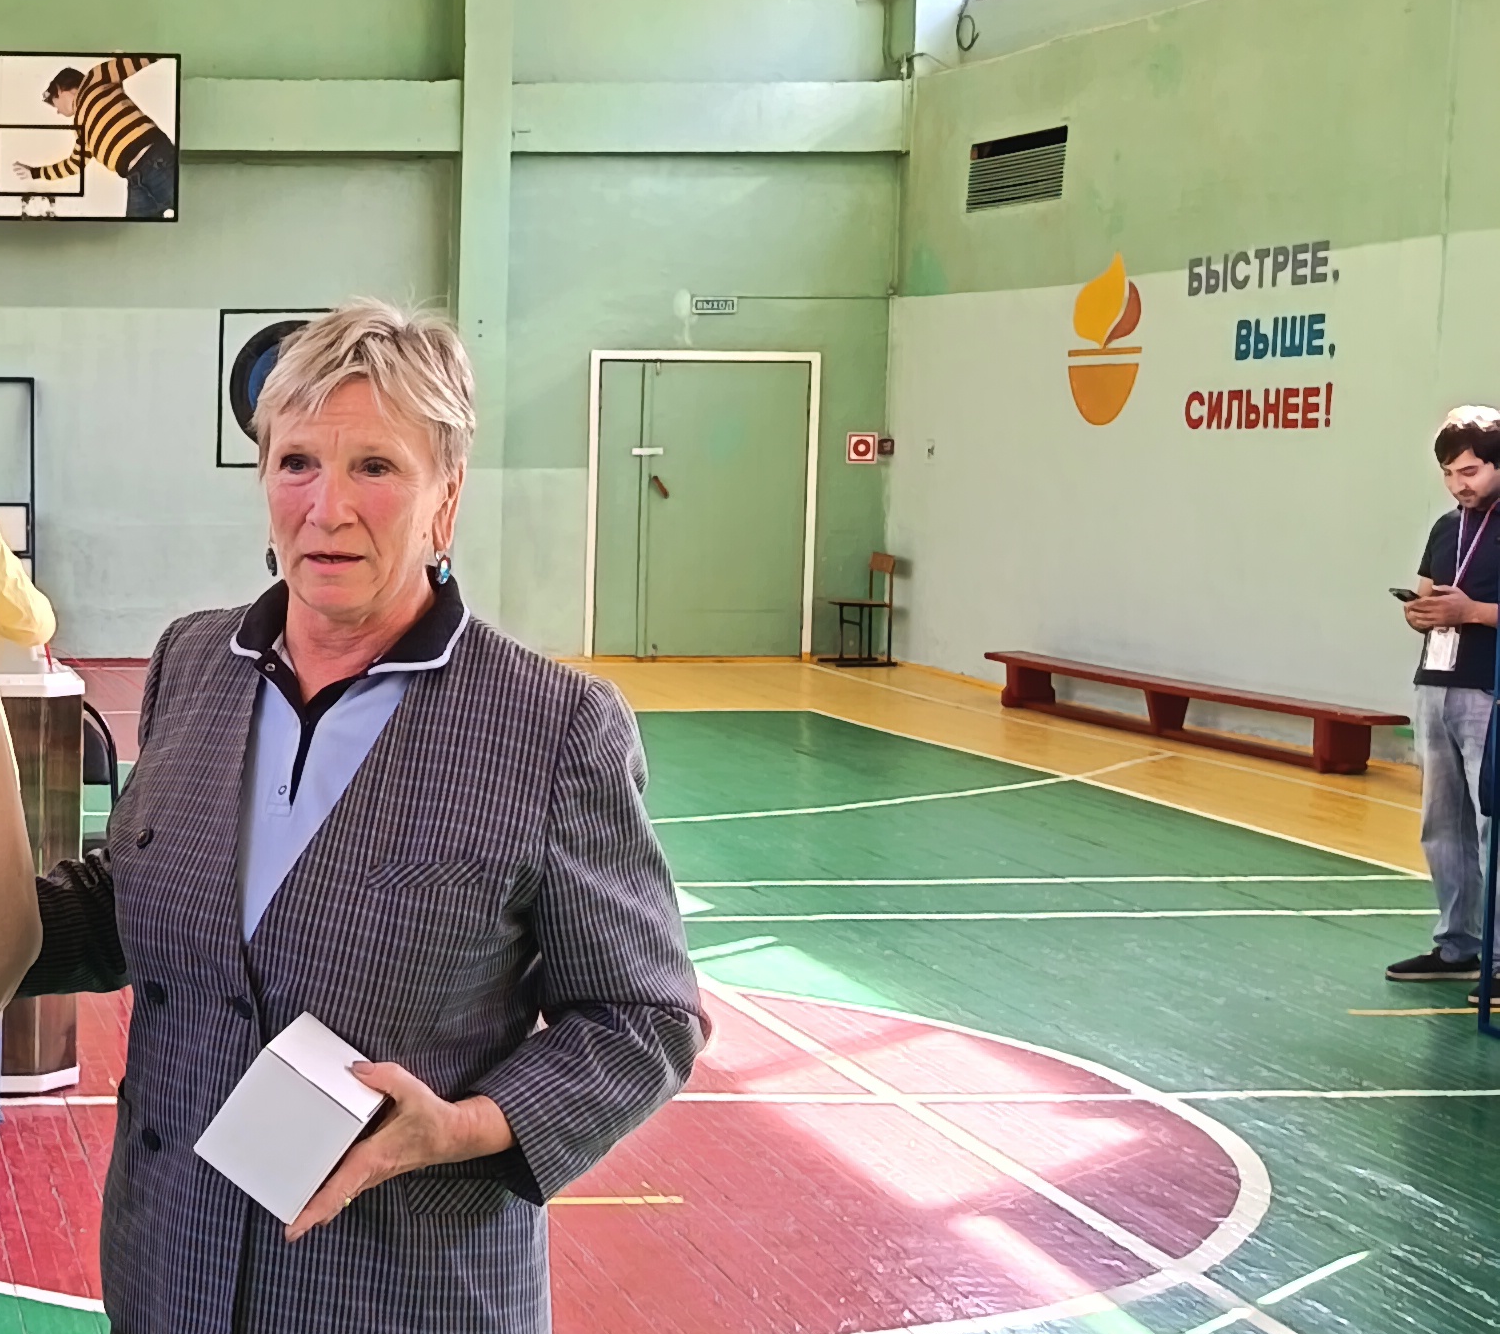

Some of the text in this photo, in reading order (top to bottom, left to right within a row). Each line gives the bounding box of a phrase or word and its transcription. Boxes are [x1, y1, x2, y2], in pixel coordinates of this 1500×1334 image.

[1187, 240, 1340, 296] БЫСТРЕЕ,
[1235, 314, 1336, 360] ВЫШЕ,
[1185, 382, 1334, 430] СИЛЬНЕЕ!
